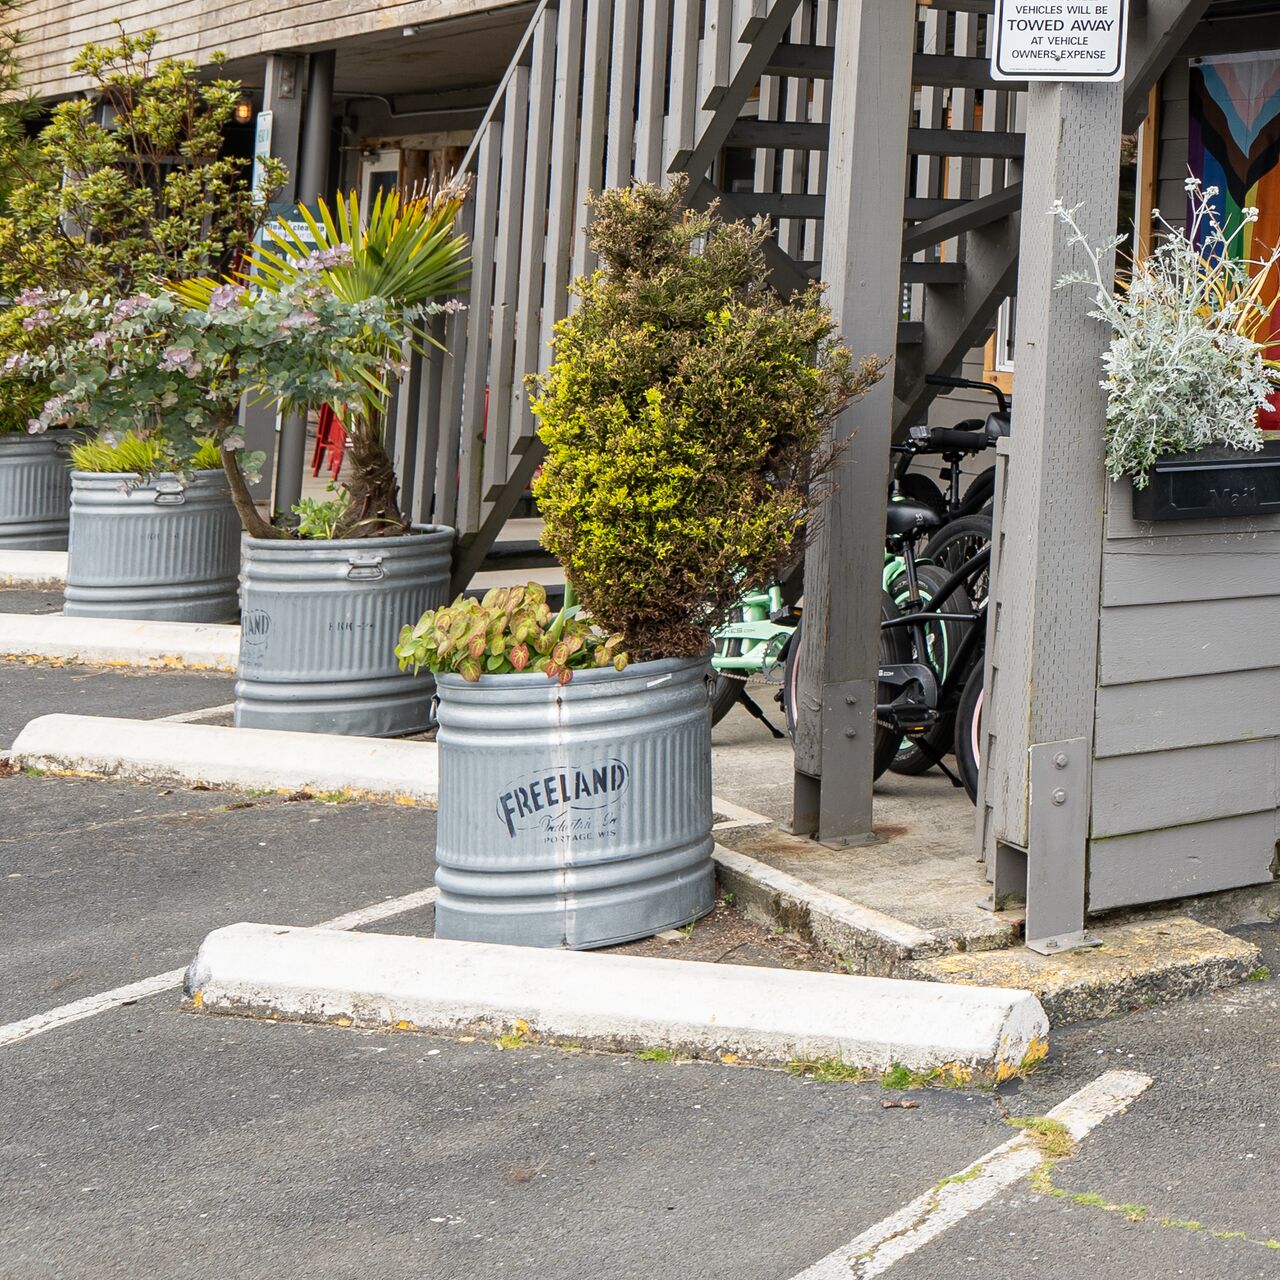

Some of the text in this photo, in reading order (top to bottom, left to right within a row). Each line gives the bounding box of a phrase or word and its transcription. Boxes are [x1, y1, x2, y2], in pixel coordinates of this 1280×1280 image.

[1016, 6, 1108, 14] VEHICLES WILL BE
[1007, 19, 1114, 31] TOWED AWAY
[1031, 36, 1088, 45] AT VEHICLE
[1012, 50, 1106, 59] OWNERS EXPENSE
[500, 764, 625, 838] FREELAND
